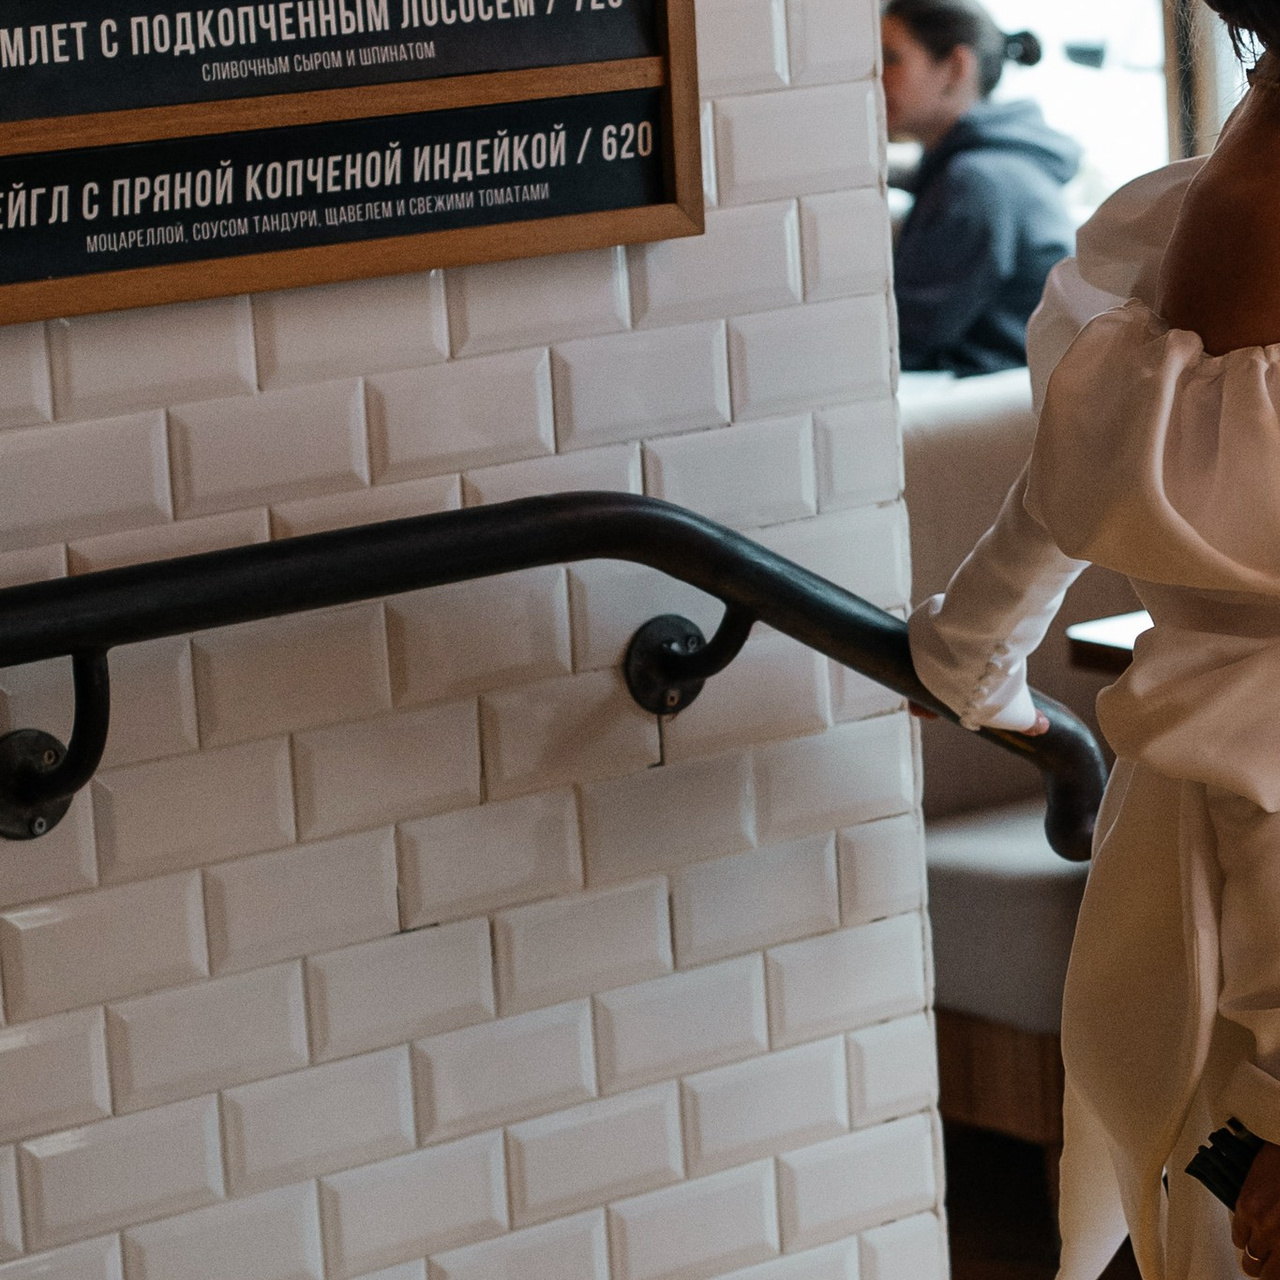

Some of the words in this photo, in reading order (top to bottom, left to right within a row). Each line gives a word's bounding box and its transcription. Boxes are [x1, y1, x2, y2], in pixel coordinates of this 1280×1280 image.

[0, 21, 87, 68] МЛЕТ
[100, 19, 118, 58] С
[202, 56, 290, 82] СЛИВОЧНЫМ
[294, 50, 343, 72] СЫРОМ
[346, 49, 356, 67] И
[359, 41, 436, 66] ШПИНАТОМ
[0, 182, 69, 229] ЙГЛ
[82, 182, 99, 220] С
[112, 160, 233, 217] ПРЯНОЙ
[246, 141, 401, 202] КОПЧЕНОЙ
[414, 123, 566, 183] ИНДЕЙКОЙ
[577, 127, 592, 164] /
[602, 121, 651, 161] 620
[192, 217, 249, 241] СОУСОМ
[325, 201, 393, 226] ЩАВЕЛЕМ
[396, 199, 405, 216] И
[409, 191, 474, 215] СВЕЖИМИ
[478, 182, 549, 207] ТОМАТАМИ
